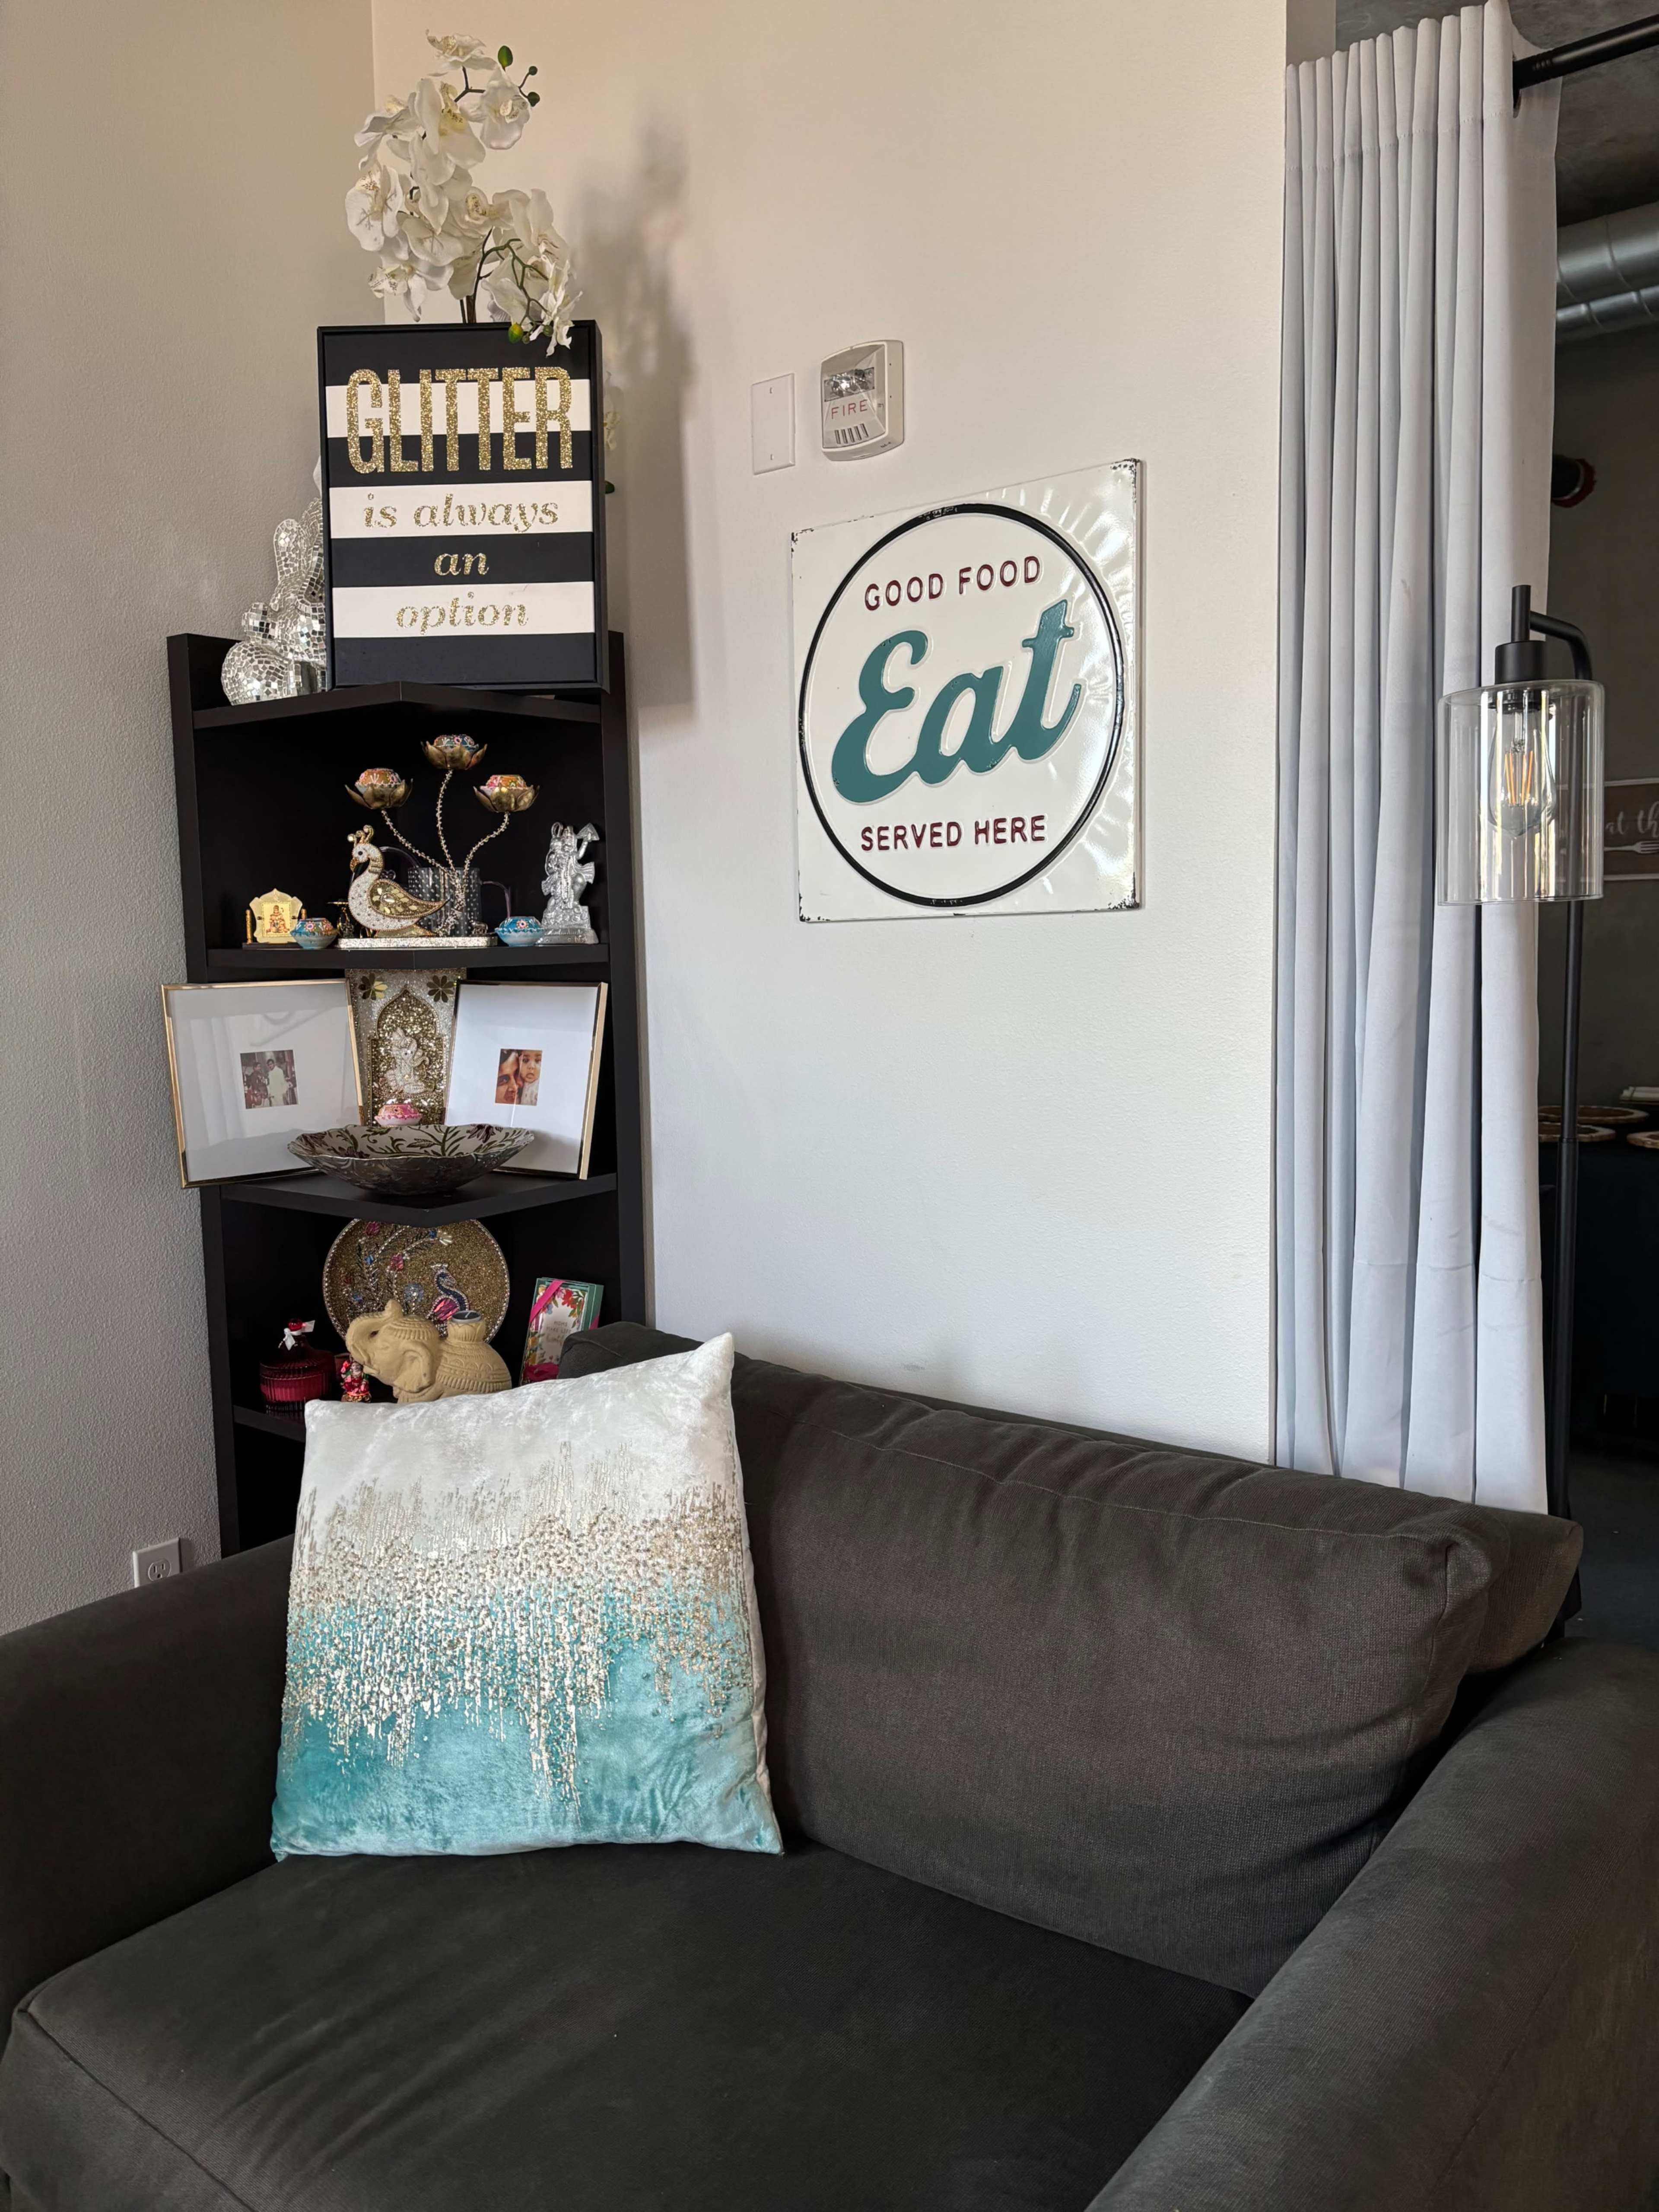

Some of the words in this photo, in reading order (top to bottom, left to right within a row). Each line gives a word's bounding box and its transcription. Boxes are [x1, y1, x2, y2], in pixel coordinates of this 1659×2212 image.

[347, 366, 573, 474] GLITTER
[831, 400, 867, 419] FIRE
[364, 493, 397, 528] is
[413, 493, 559, 533] always
[434, 553, 489, 576] an
[864, 573, 944, 611] GOOD
[959, 556, 1041, 595] FOOD
[395, 592, 528, 635] option
[831, 599, 1082, 803] Eat
[861, 821, 963, 852] SERVED
[974, 815, 1046, 844] HERE
